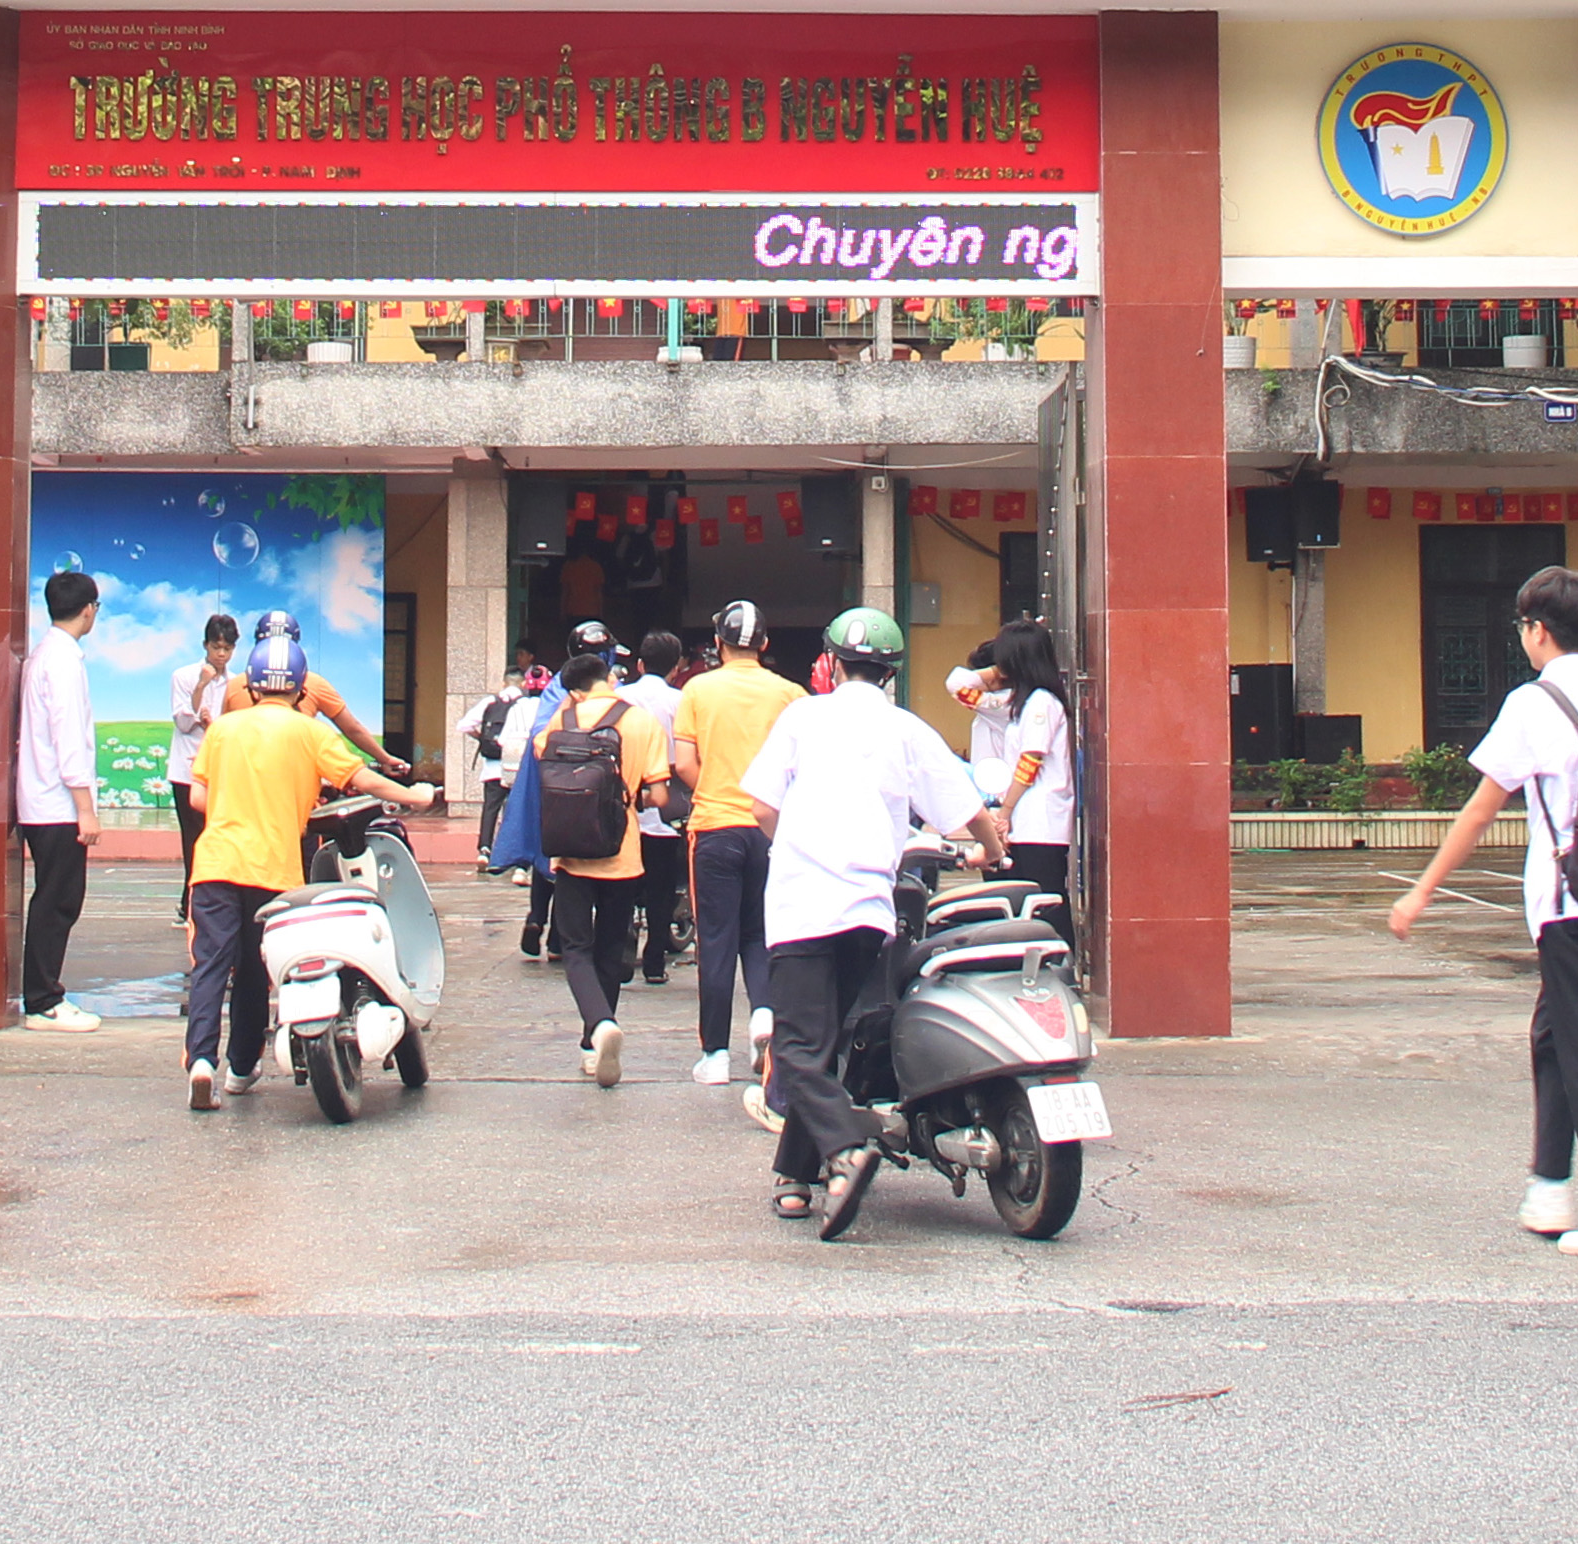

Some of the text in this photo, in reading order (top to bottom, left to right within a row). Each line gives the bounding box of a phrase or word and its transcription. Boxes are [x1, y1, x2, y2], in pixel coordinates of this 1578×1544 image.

[64, 25, 87, 34] BAN
[174, 25, 199, 35] NINH
[70, 44, 1044, 155] TRƯỜNG TRUNG HỌC PHỔ THÔNG B NGUYỄN HUỆ
[1437, 52, 1488, 98] THPT
[753, 214, 985, 279] Chuyên
